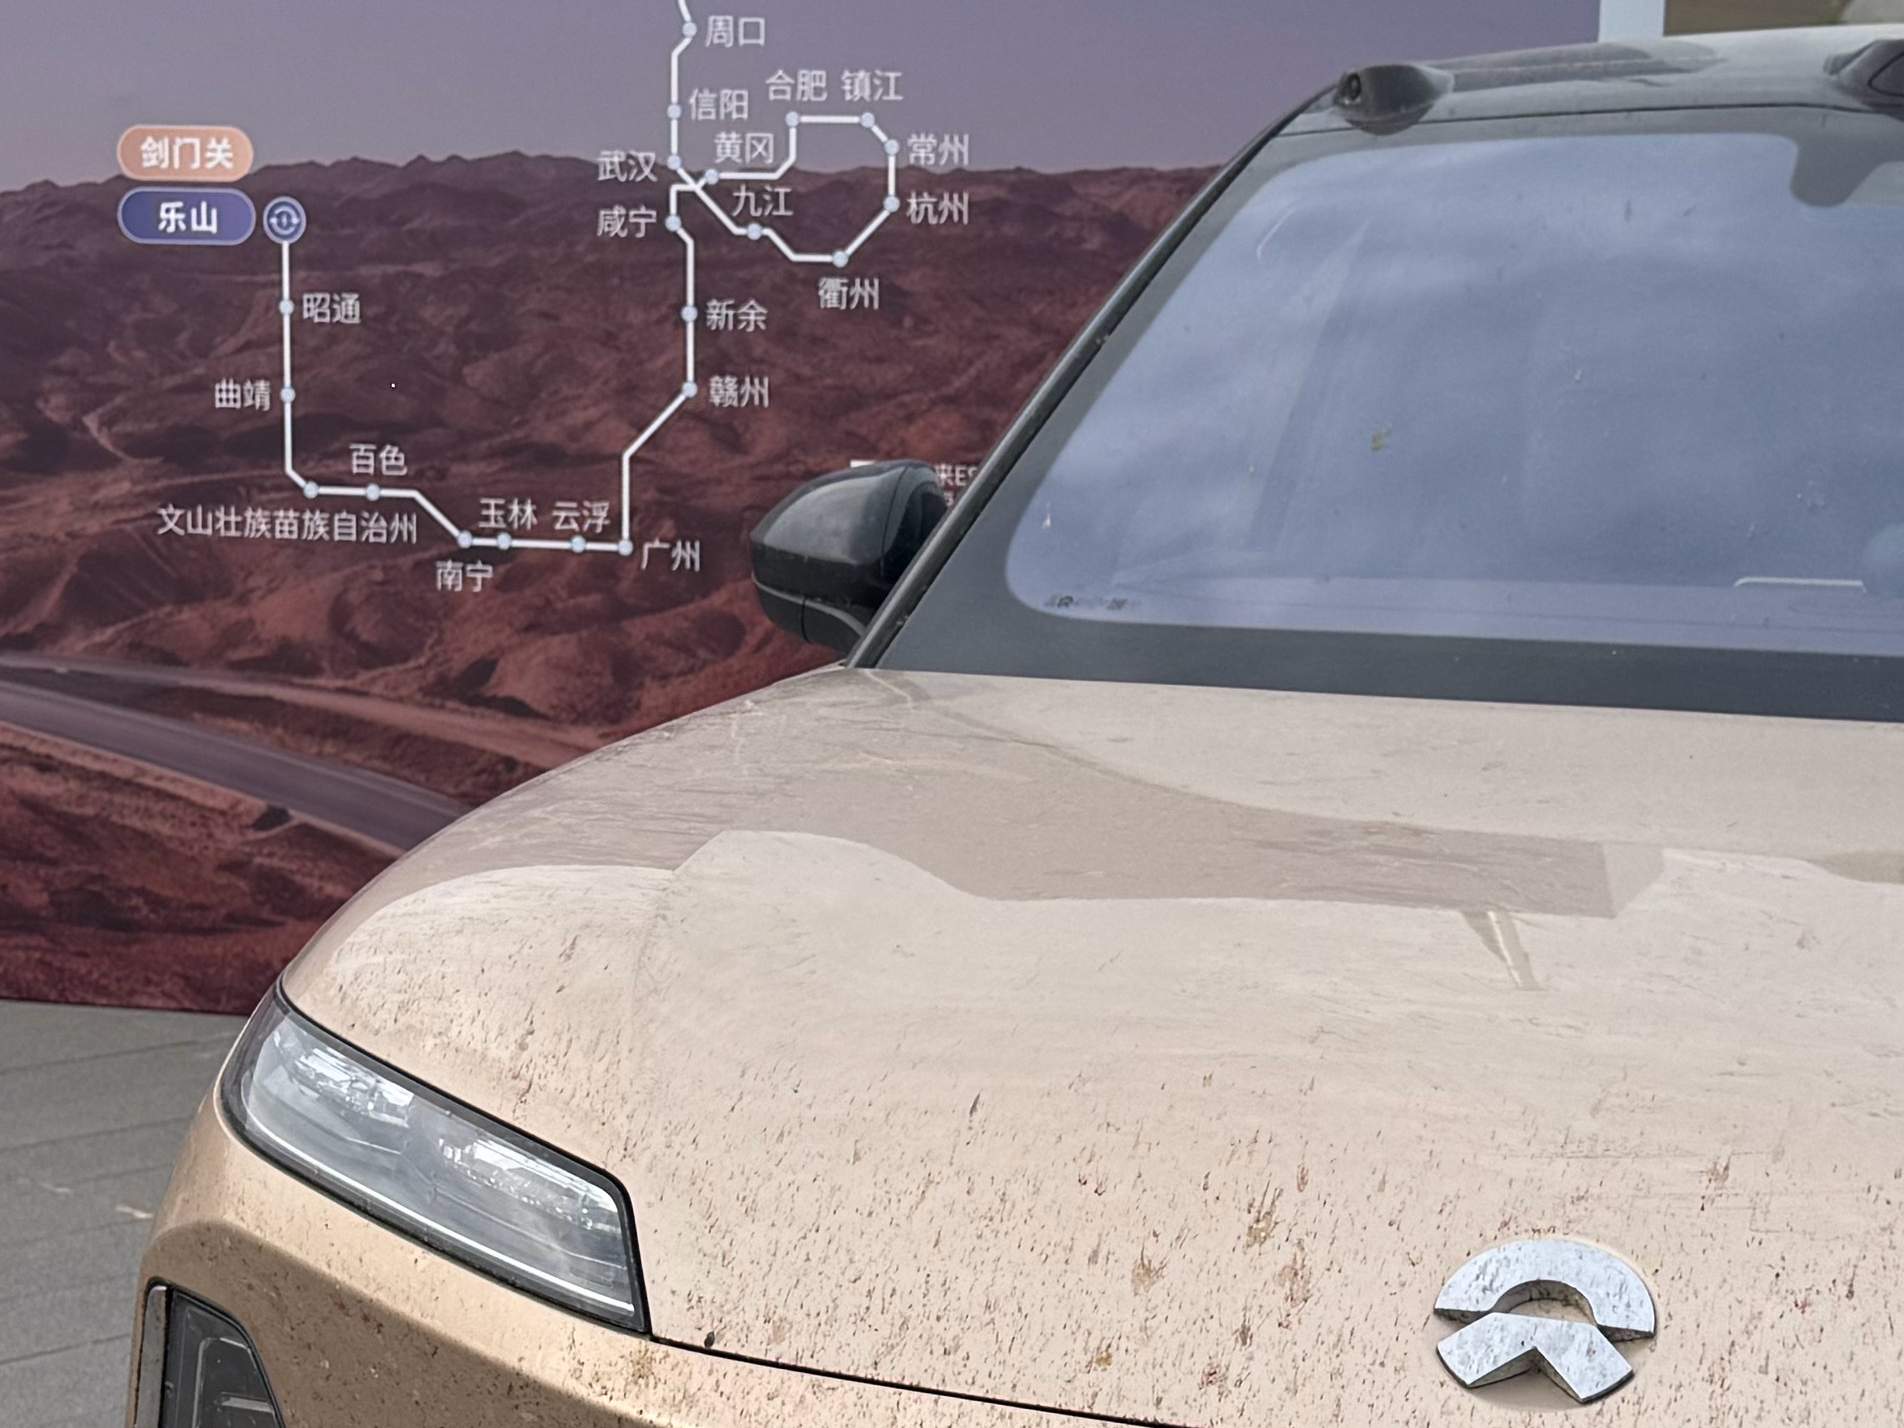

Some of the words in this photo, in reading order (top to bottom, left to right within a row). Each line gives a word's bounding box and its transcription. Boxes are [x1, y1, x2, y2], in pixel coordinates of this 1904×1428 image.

[706, 16, 765, 47] 周口
[766, 70, 827, 101] 合肥
[842, 70, 903, 101] 镇江
[689, 89, 748, 120] 信阳
[141, 137, 233, 169] 剑门关
[715, 132, 773, 164] 黄冈
[908, 134, 968, 165] 常州
[597, 150, 657, 182] 武汉
[732, 184, 793, 216] 九江
[907, 192, 968, 224] 杭州
[159, 201, 217, 233] 乐山
[598, 206, 656, 237] 咸宁
[303, 293, 359, 323] 昭通
[819, 278, 878, 309] 衢州
[707, 299, 767, 332] 新余
[215, 379, 270, 410] 曲靖
[710, 376, 768, 407] 赣州
[350, 444, 407, 475] 百色
[157, 504, 417, 544] 文山壮族苗族自治州
[479, 499, 537, 529] 玉林
[552, 501, 609, 533] 云浮
[642, 538, 699, 571] 广州
[437, 560, 492, 592] 南宁
